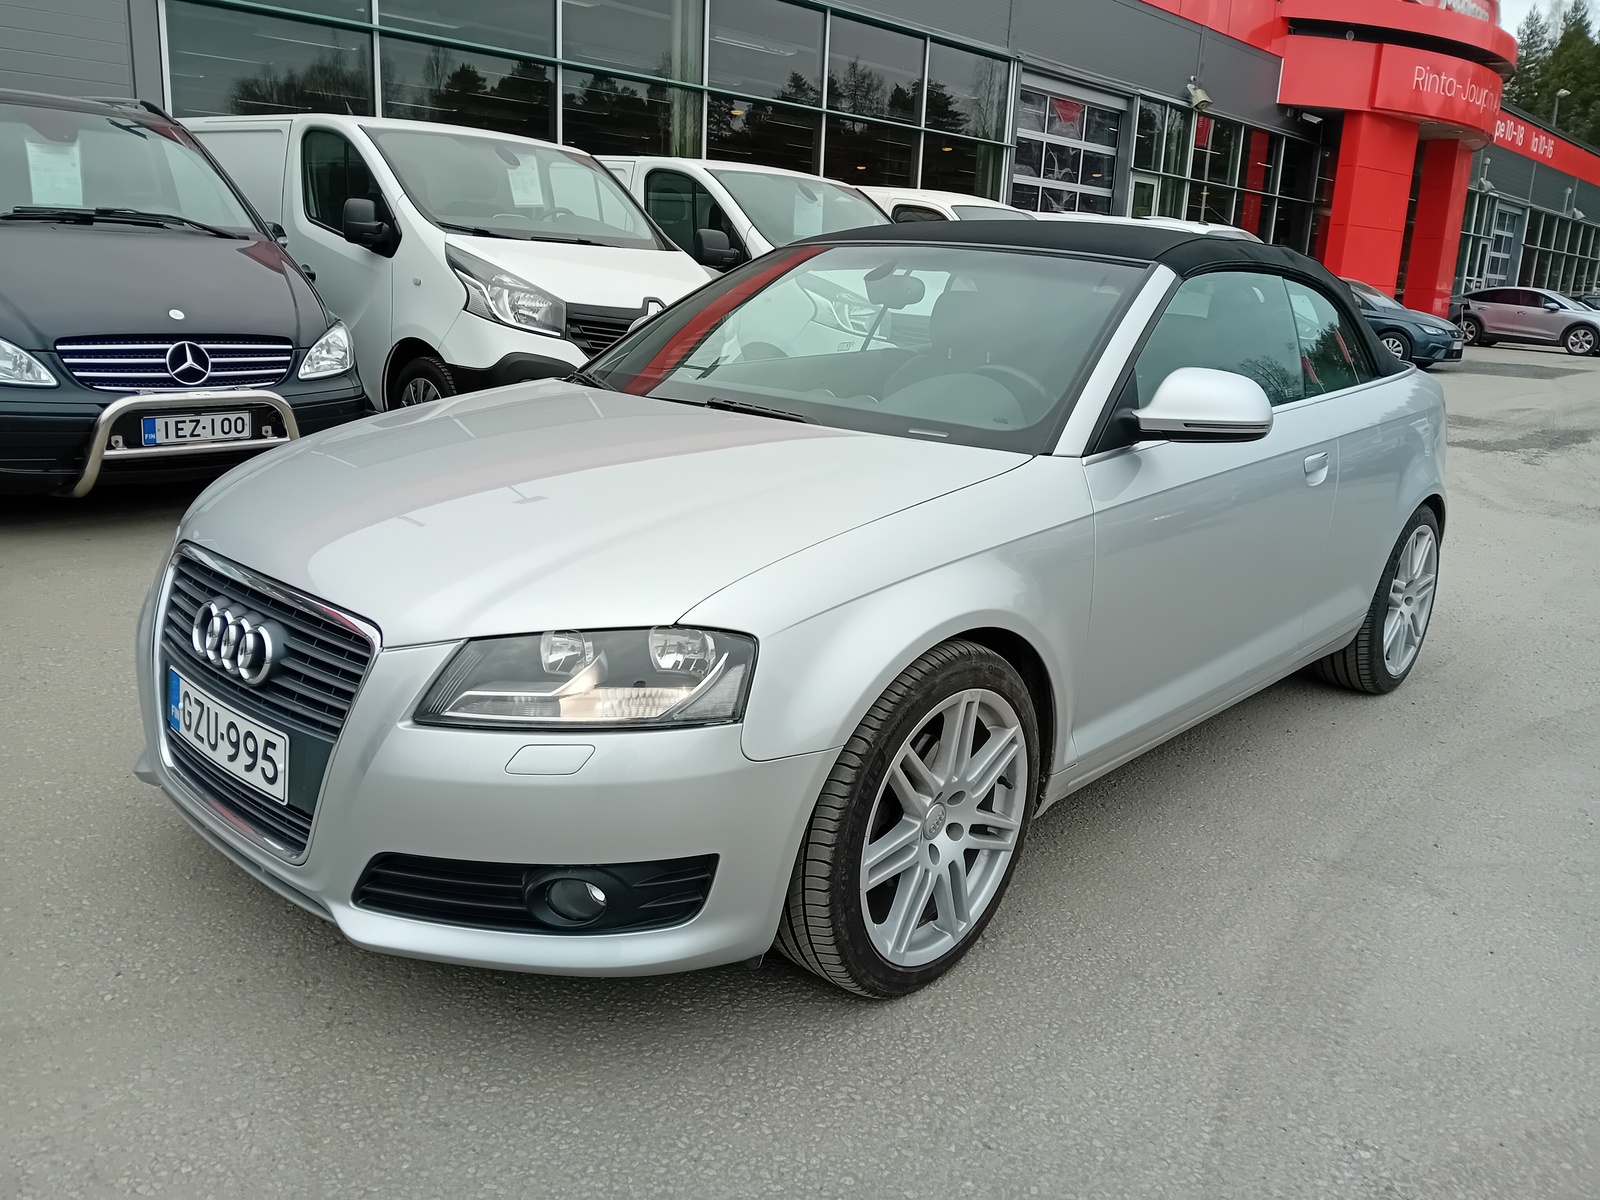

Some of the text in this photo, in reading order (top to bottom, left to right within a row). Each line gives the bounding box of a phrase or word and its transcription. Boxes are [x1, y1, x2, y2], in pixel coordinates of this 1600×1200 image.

[1493, 120, 1555, 159] pe 10-18 la 10-16
[164, 416, 245, 440] IEZ-100
[172, 690, 278, 785] FIN GZU-995
